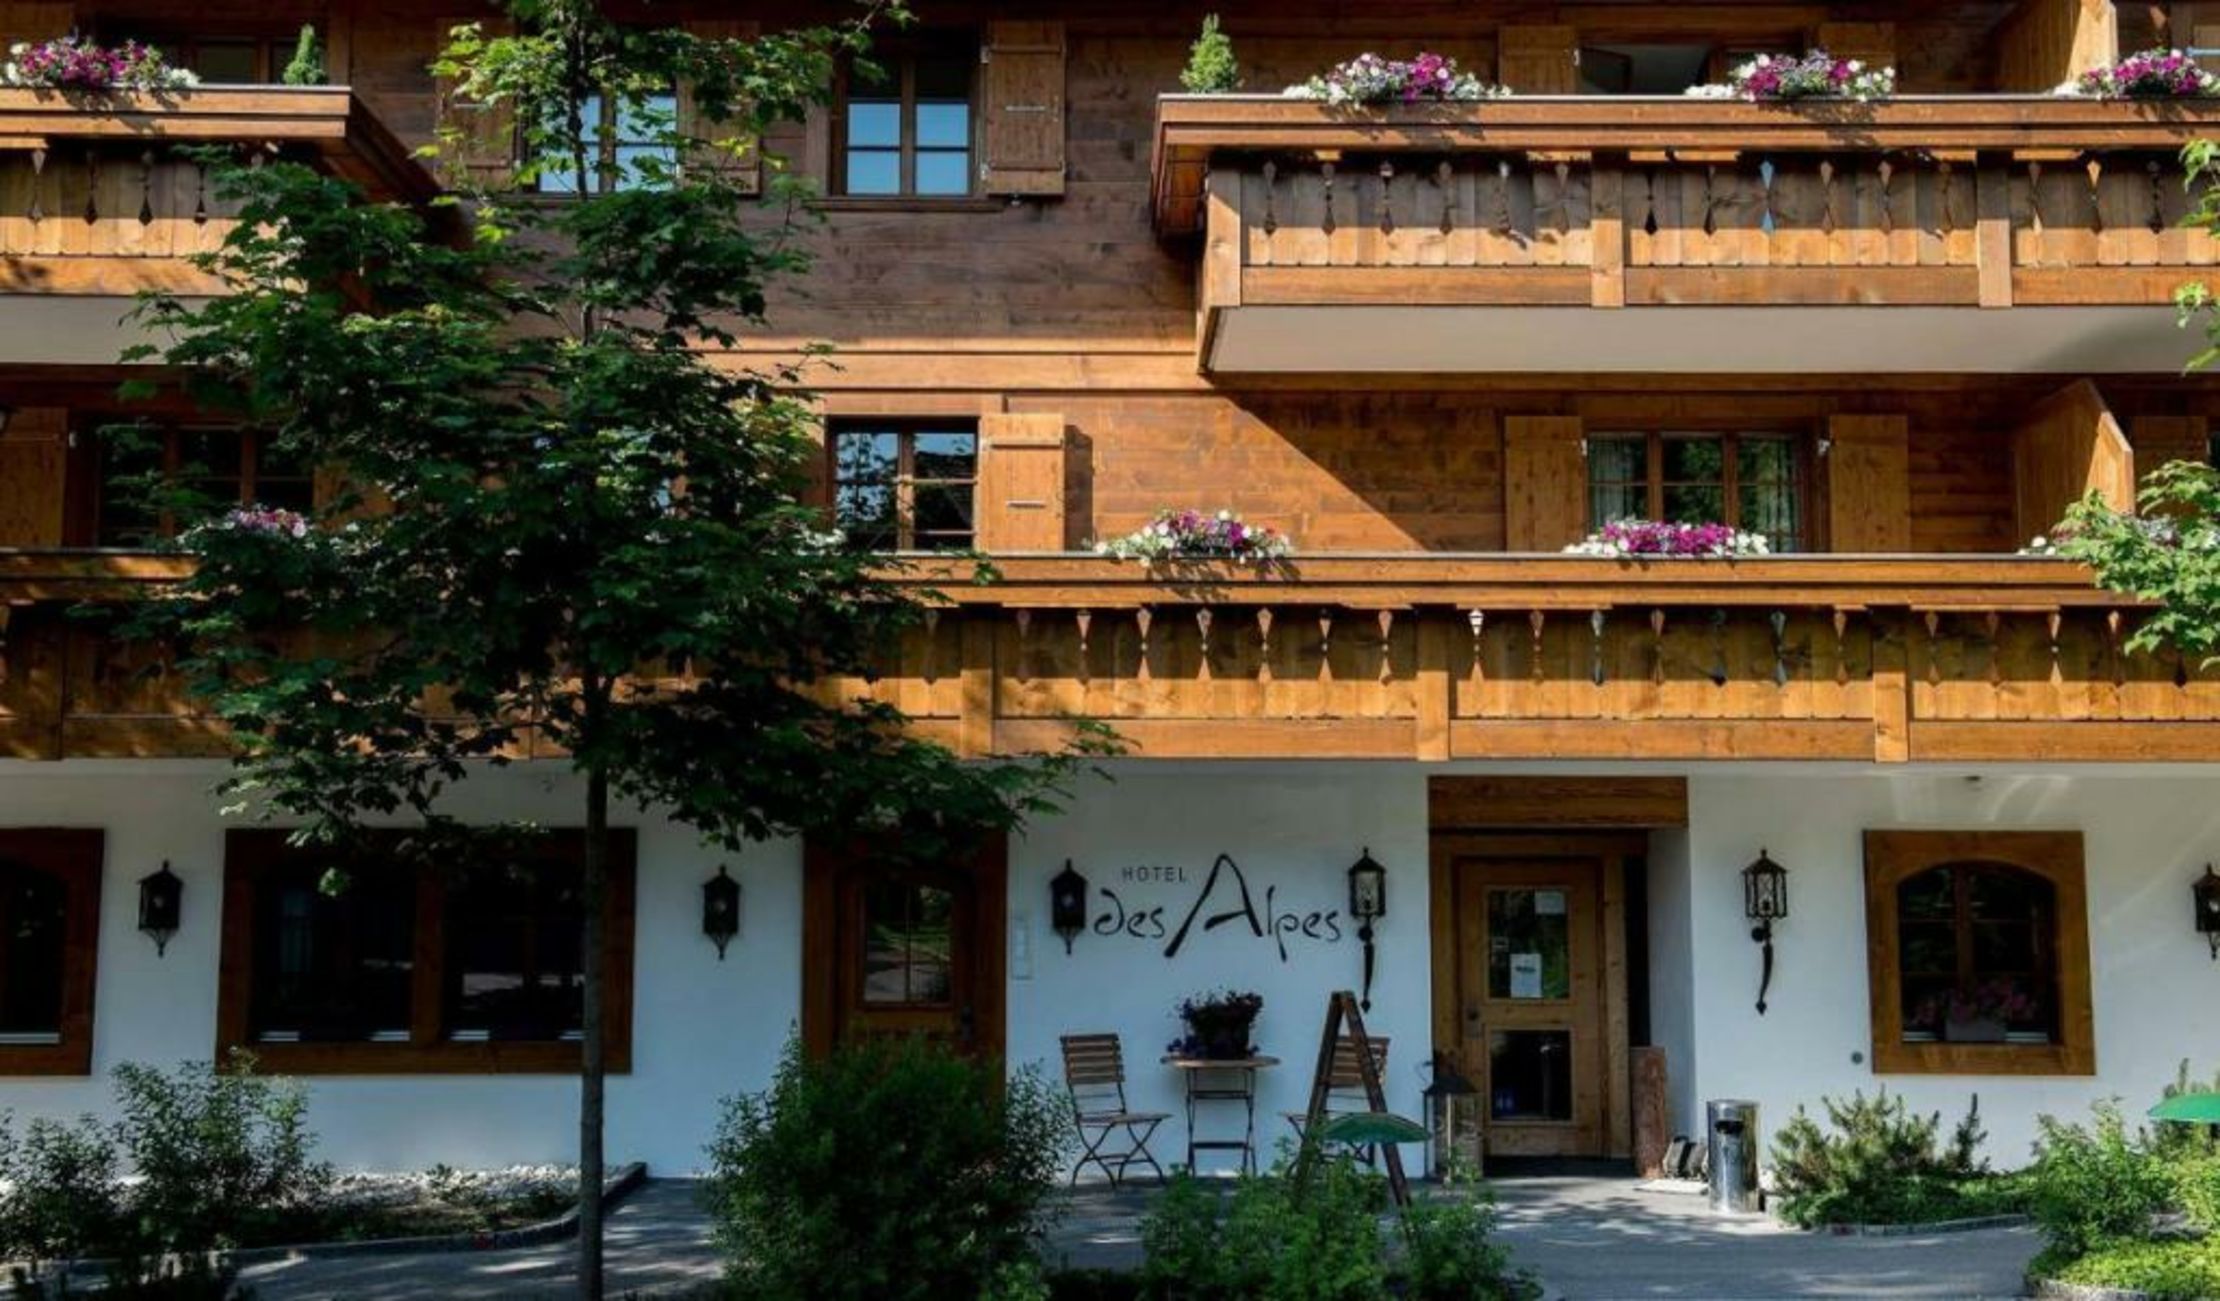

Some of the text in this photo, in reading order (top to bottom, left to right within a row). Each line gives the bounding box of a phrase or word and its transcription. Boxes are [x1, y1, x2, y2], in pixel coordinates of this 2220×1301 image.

[1121, 867, 1187, 883] HOTEL
[1094, 853, 1342, 962] des Alpes
